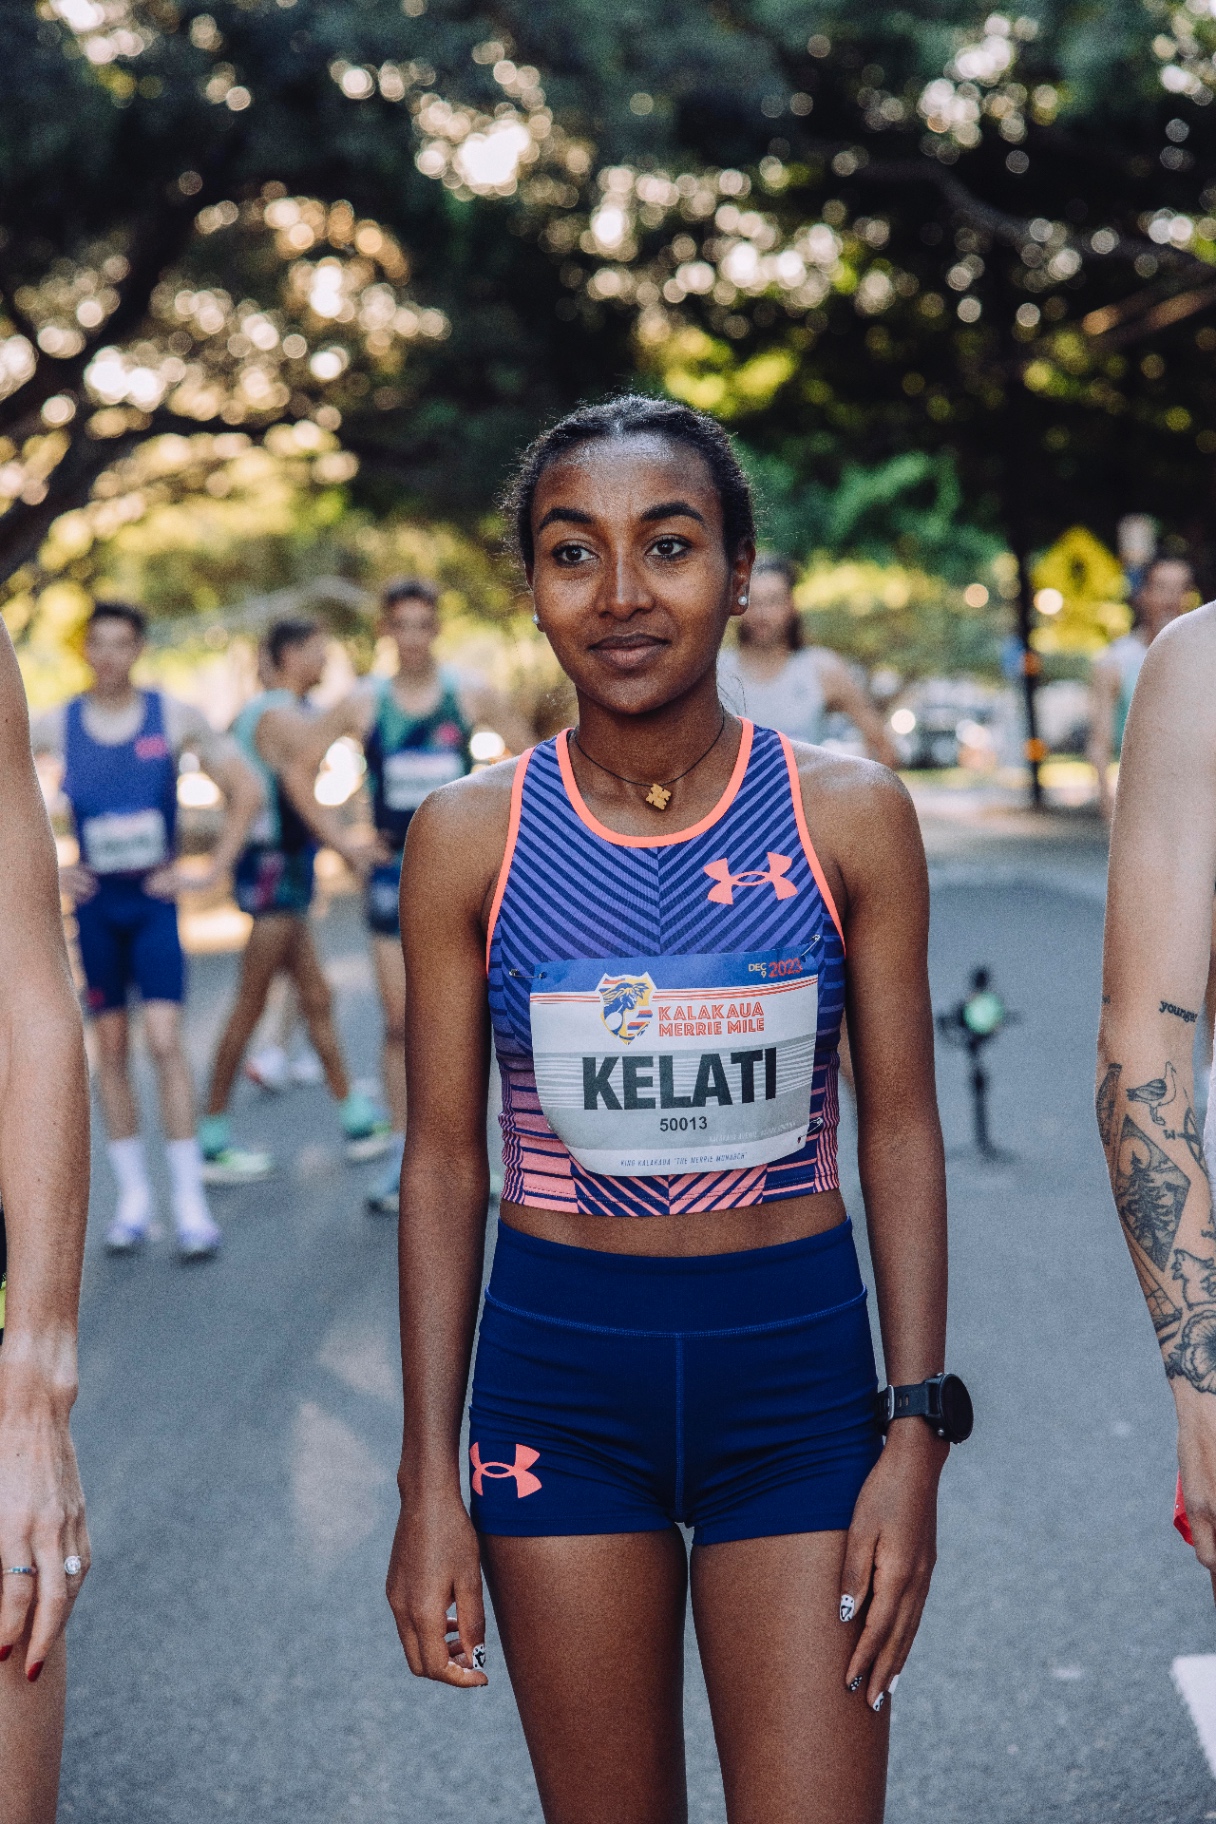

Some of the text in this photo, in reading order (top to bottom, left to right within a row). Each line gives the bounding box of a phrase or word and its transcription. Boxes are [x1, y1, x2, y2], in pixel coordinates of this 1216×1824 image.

[748, 962, 767, 972] DEC
[761, 971, 767, 979] 9
[768, 957, 803, 978] 2023
[658, 1001, 764, 1021] KALAKAUA
[659, 1018, 765, 1037] MERRIE MILE
[582, 1047, 777, 1110] KELATI
[659, 1116, 708, 1132] 50013
